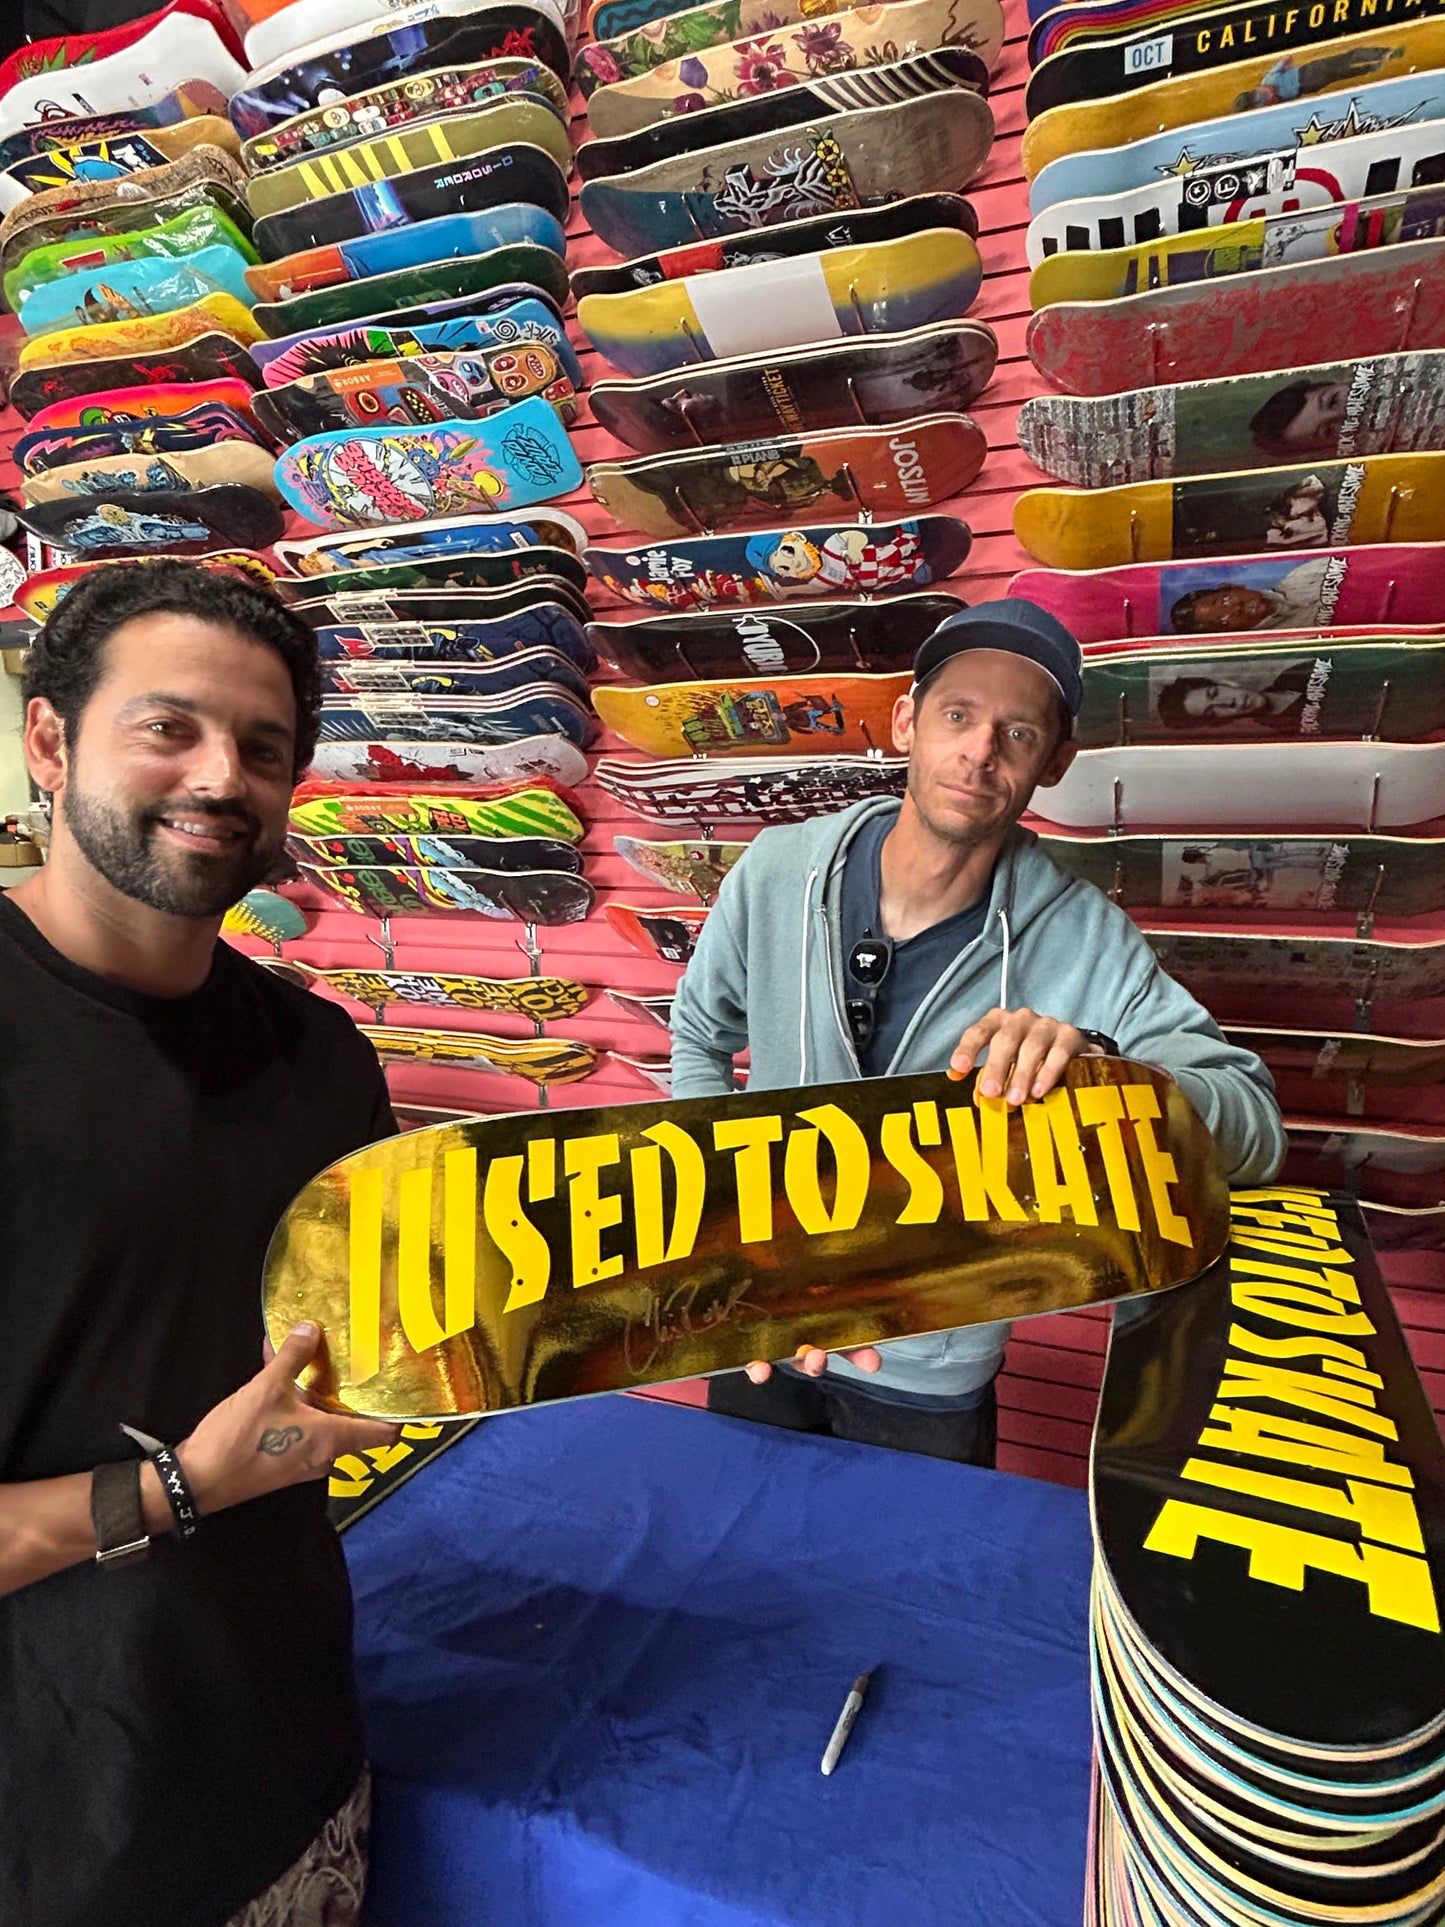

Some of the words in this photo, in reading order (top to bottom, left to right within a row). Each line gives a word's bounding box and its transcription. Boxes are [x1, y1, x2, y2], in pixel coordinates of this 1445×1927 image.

[1131, 42, 1164, 68] OCT
[434, 154, 514, 189] DISORDER
[764, 367, 790, 404] TICKET
[888, 437, 931, 504] JOSLIN
[399, 1120, 706, 1353] USED
[713, 1103, 870, 1244] TO
[881, 1084, 1195, 1249] SKATE
[1229, 1257, 1377, 1336] TO
[1142, 1322, 1441, 1633] SKATE
